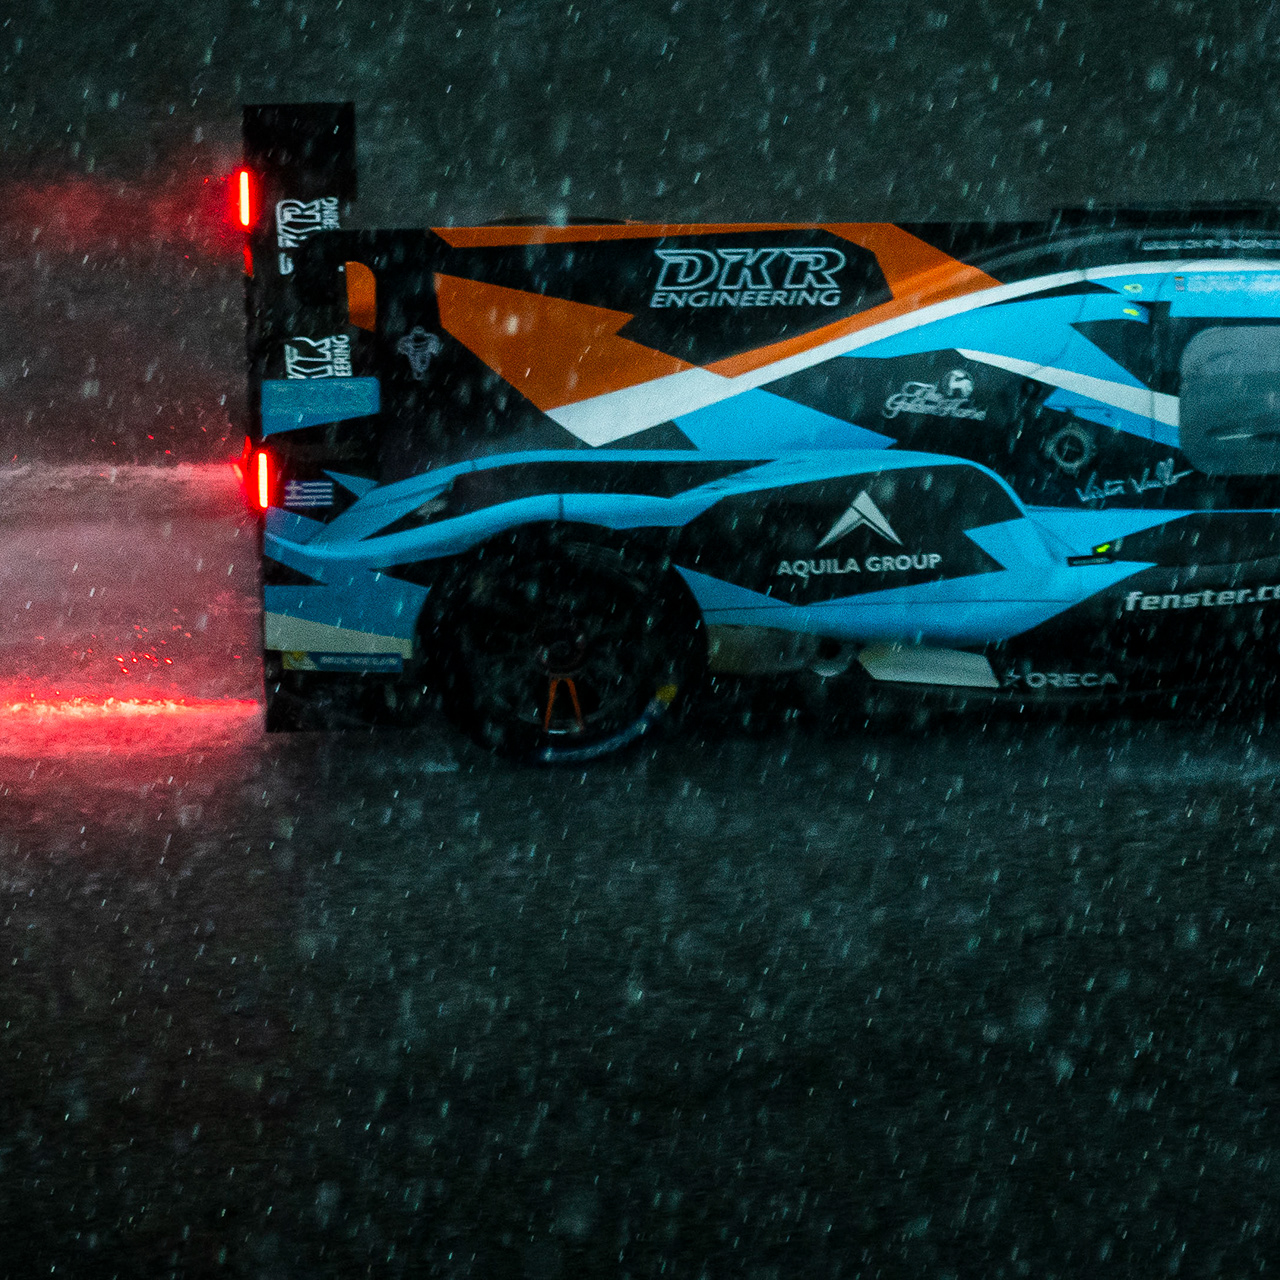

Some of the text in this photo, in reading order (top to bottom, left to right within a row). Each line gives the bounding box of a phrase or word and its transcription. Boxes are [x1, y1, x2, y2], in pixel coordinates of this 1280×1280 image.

[653, 247, 846, 290] DKR
[649, 290, 841, 308] ENGINEERING
[776, 553, 942, 578] AQUILA GROUP
[1025, 672, 1118, 689] ORECA
